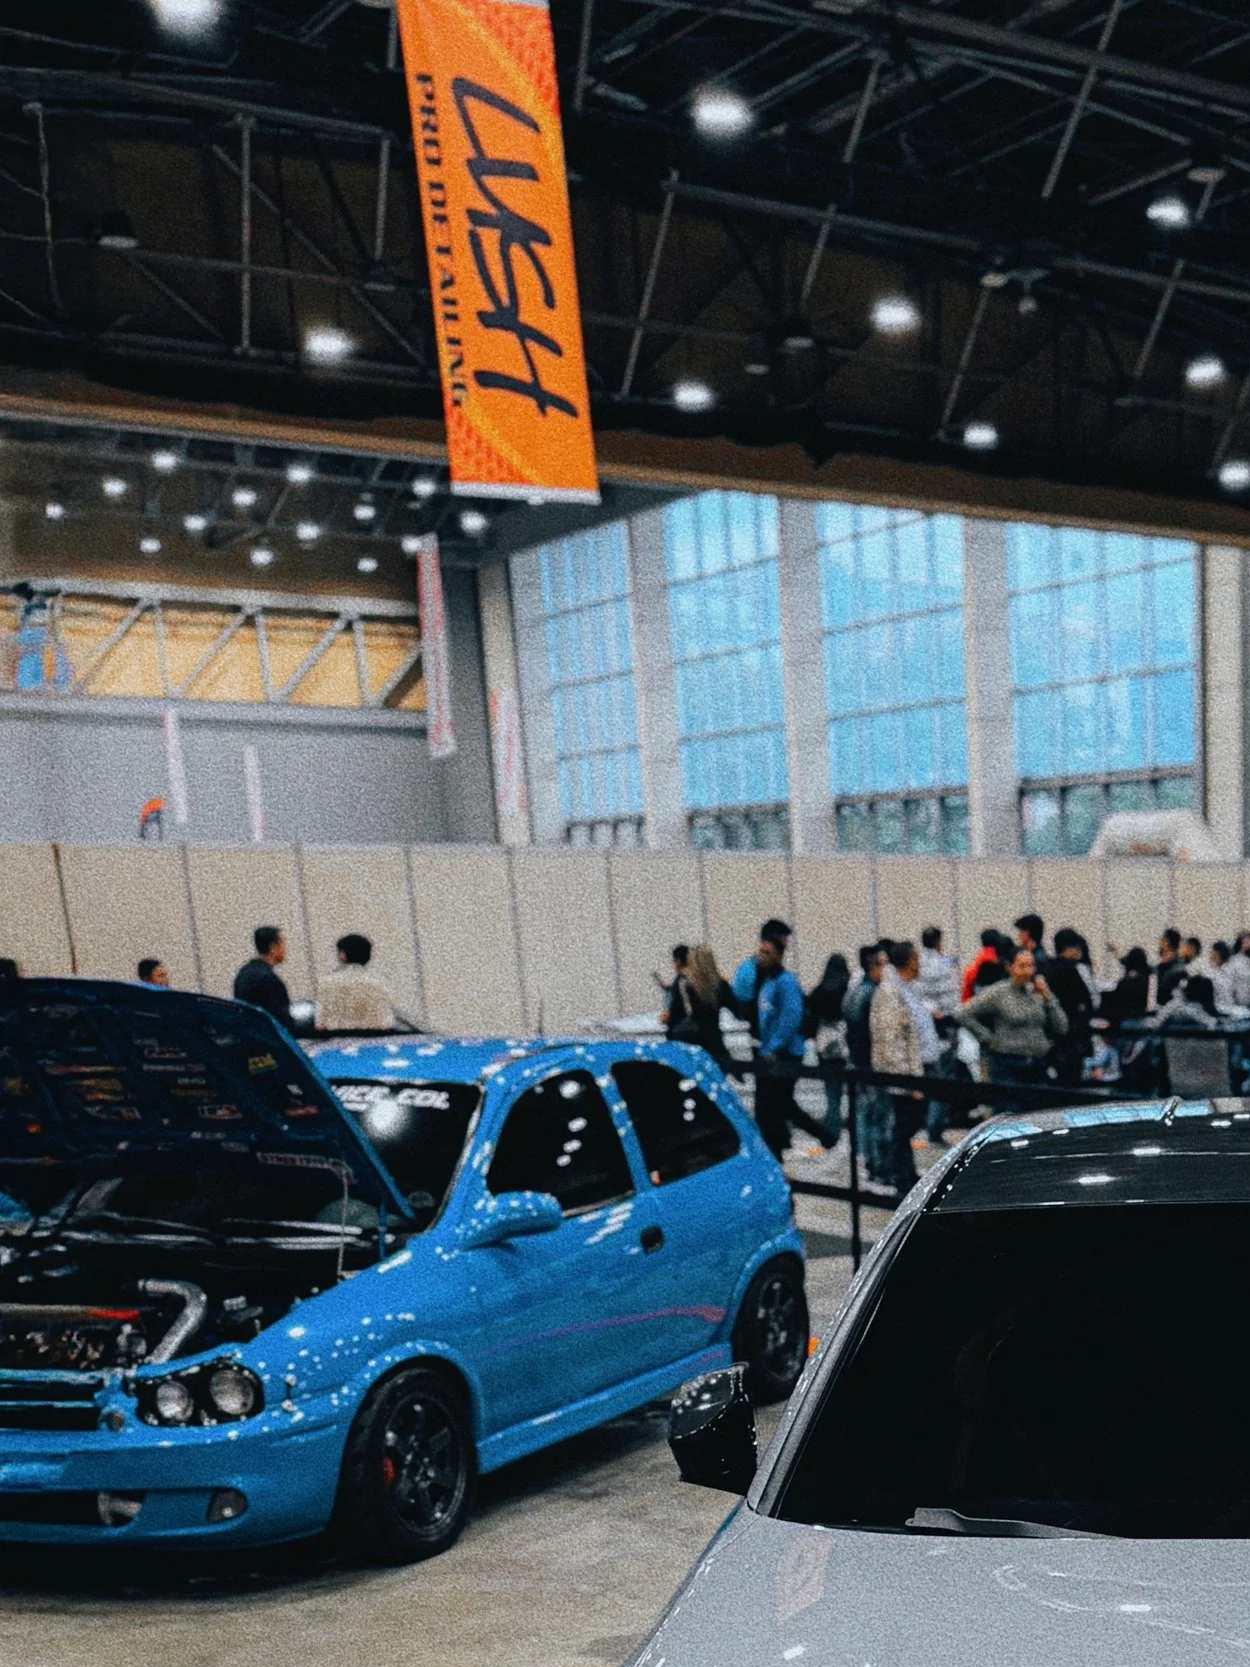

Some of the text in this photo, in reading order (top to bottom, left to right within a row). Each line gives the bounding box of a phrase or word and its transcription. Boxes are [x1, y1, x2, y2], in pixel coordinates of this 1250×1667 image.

[416, 73, 467, 407] PRO DETAILING
[452, 77, 578, 417] LUSH
